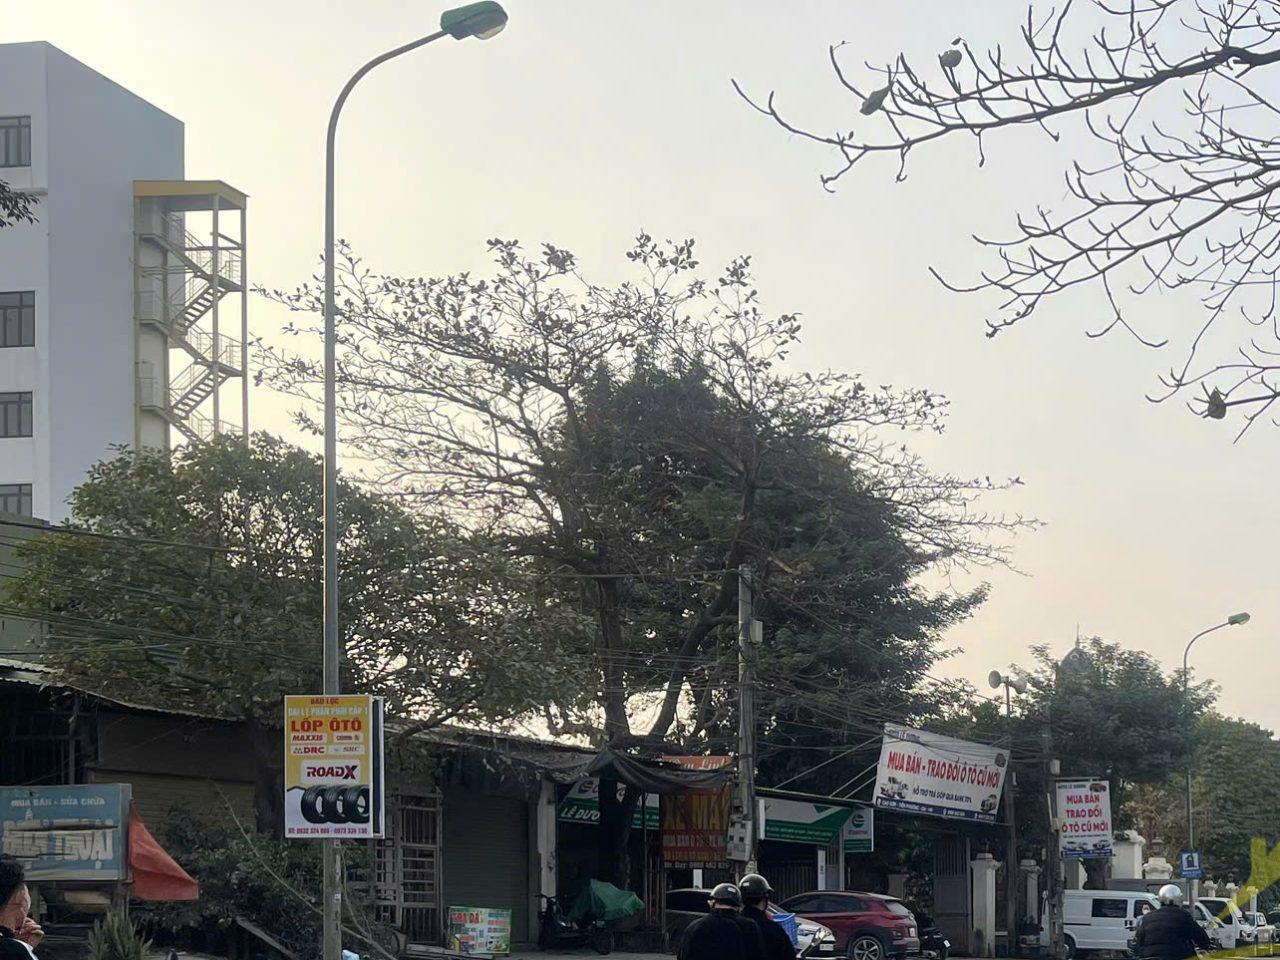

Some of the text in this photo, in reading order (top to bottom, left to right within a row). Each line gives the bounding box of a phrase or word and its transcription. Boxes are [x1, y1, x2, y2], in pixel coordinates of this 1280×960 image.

[291, 718, 323, 732] LỐP
[306, 765, 358, 780] ROADX
[888, 751, 905, 771] MUA
[905, 751, 922, 774] BÁN
[926, 759, 946, 779] TRAO
[946, 756, 960, 781] ĐỔI
[1066, 792, 1100, 804] MUA BÁN
[1066, 809, 1087, 818] TRAO
